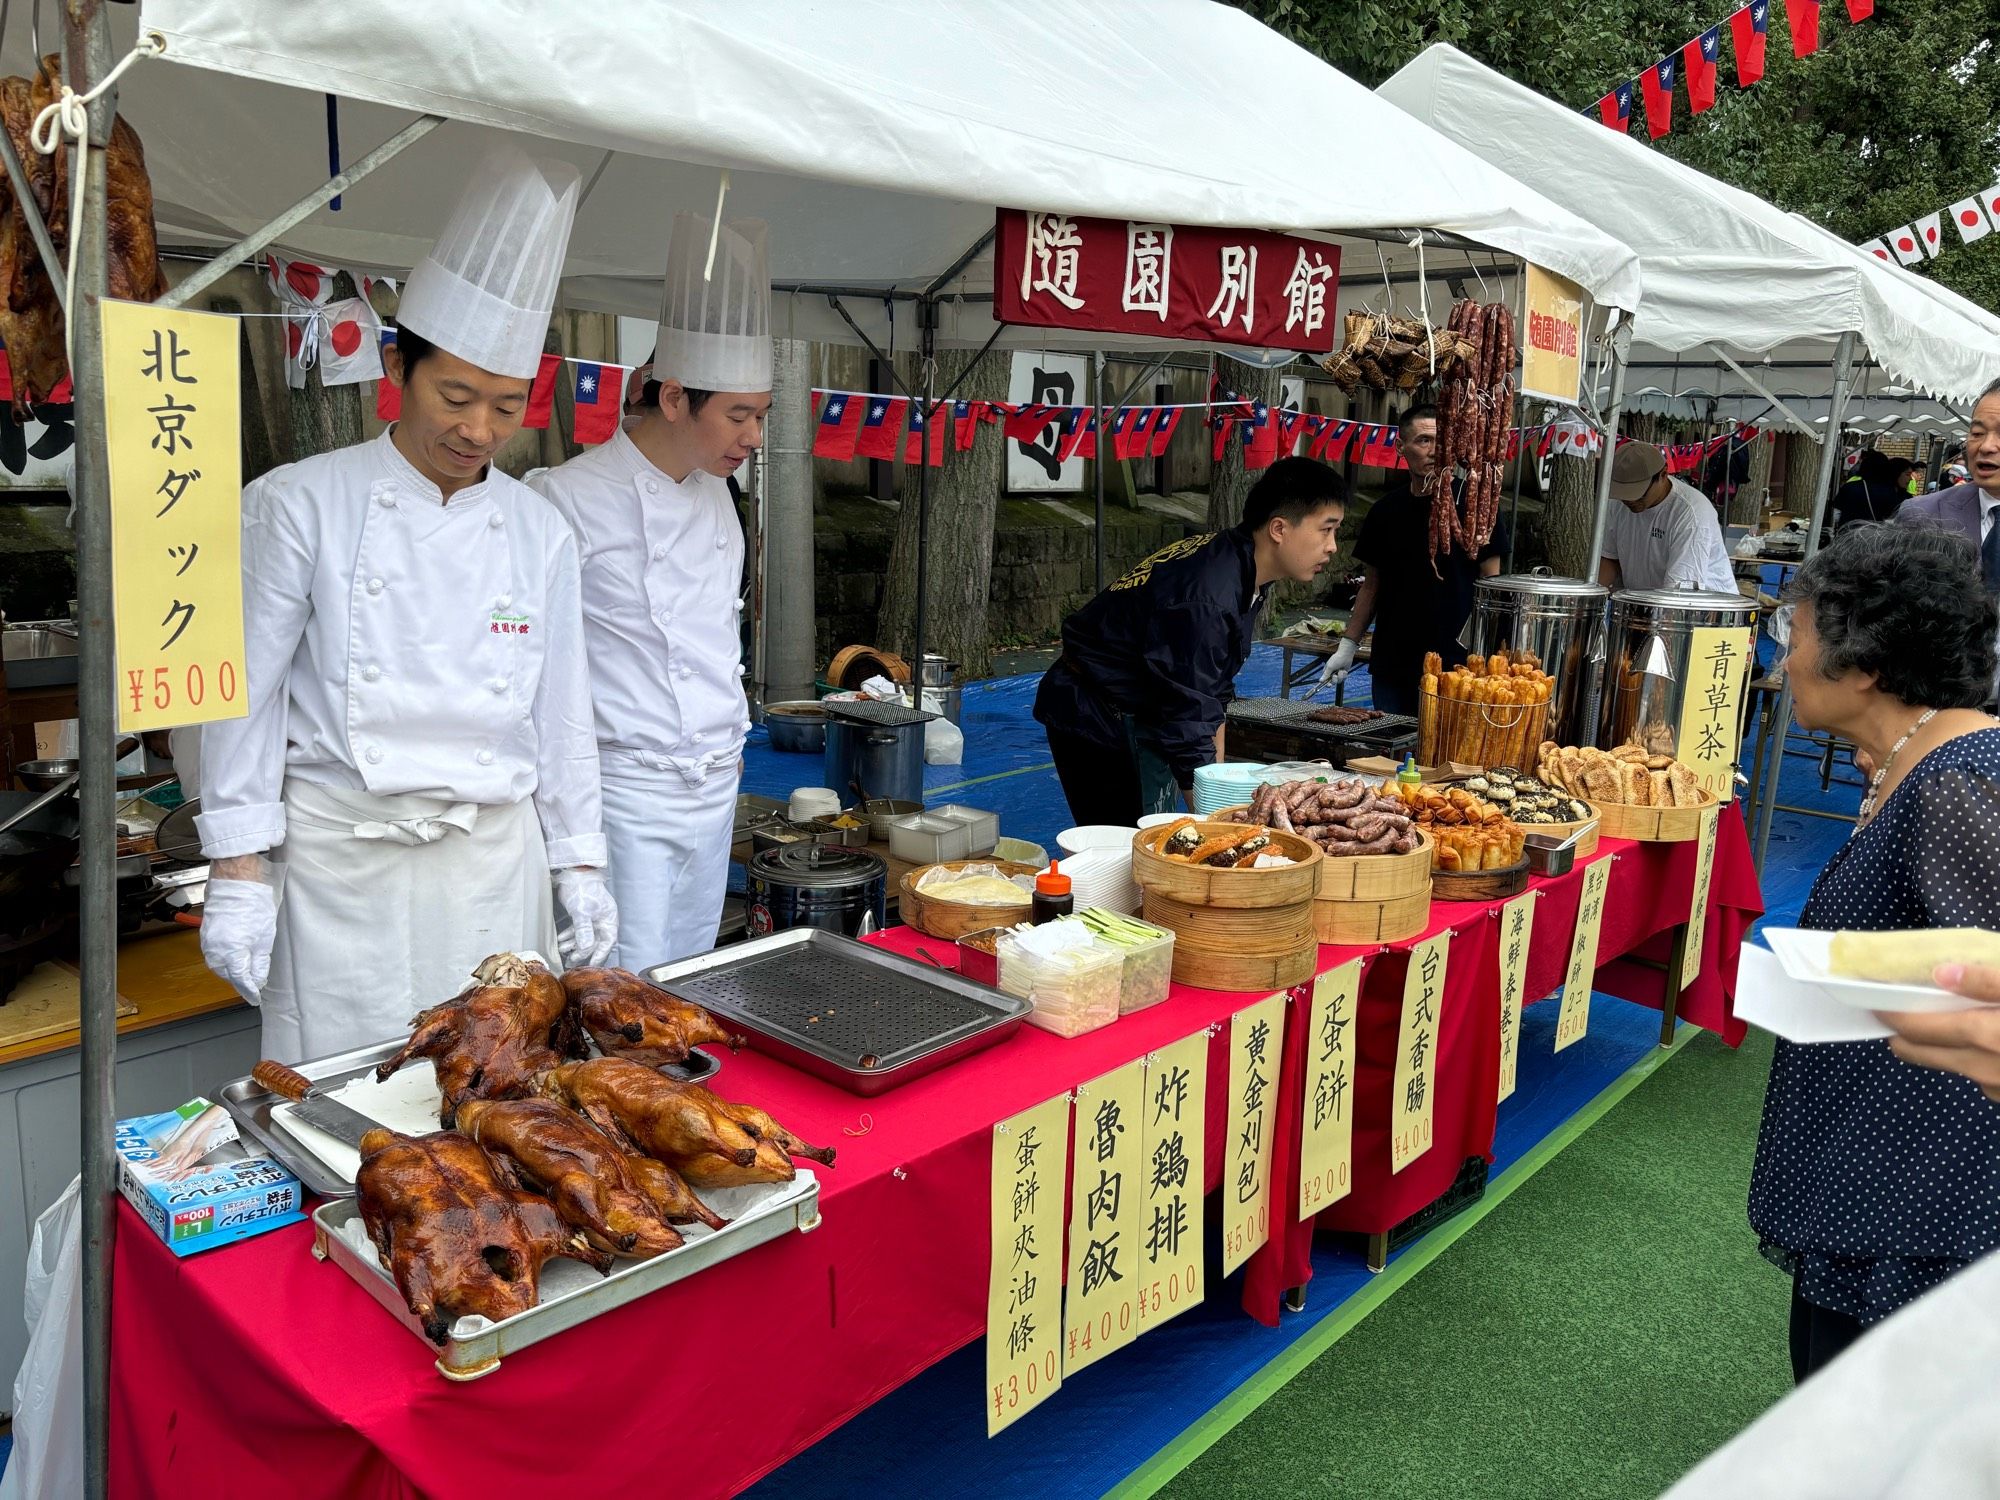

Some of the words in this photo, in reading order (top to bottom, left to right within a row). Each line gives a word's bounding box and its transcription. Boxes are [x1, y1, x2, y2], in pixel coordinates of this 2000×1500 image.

[141, 329, 201, 652] 北京ダック
[128, 661, 236, 713] ¥500
[1694, 640, 1737, 761] 青草茶
[1404, 946, 1440, 1115] 台式香腸
[1558, 1010, 1586, 1042] ¥500
[1312, 993, 1351, 1131] 蛋餅
[1144, 1066, 1191, 1265] 炸鶏排
[1394, 1118, 1429, 1161] ¥400
[169, 1173, 285, 1203] ポリエチレン
[266, 1188, 293, 1205] 手袋
[1079, 1099, 1126, 1298] 魯肉飯
[1304, 1161, 1347, 1207] ¥200
[218, 1201, 292, 1228] ポリエチレン
[1226, 1206, 1266, 1259] ¥500
[1006, 1126, 1042, 1361] 蛋餅夾油條
[1138, 1264, 1196, 1319] ¥500
[1068, 1300, 1130, 1360] ¥400
[993, 1350, 1056, 1418] ¥300
